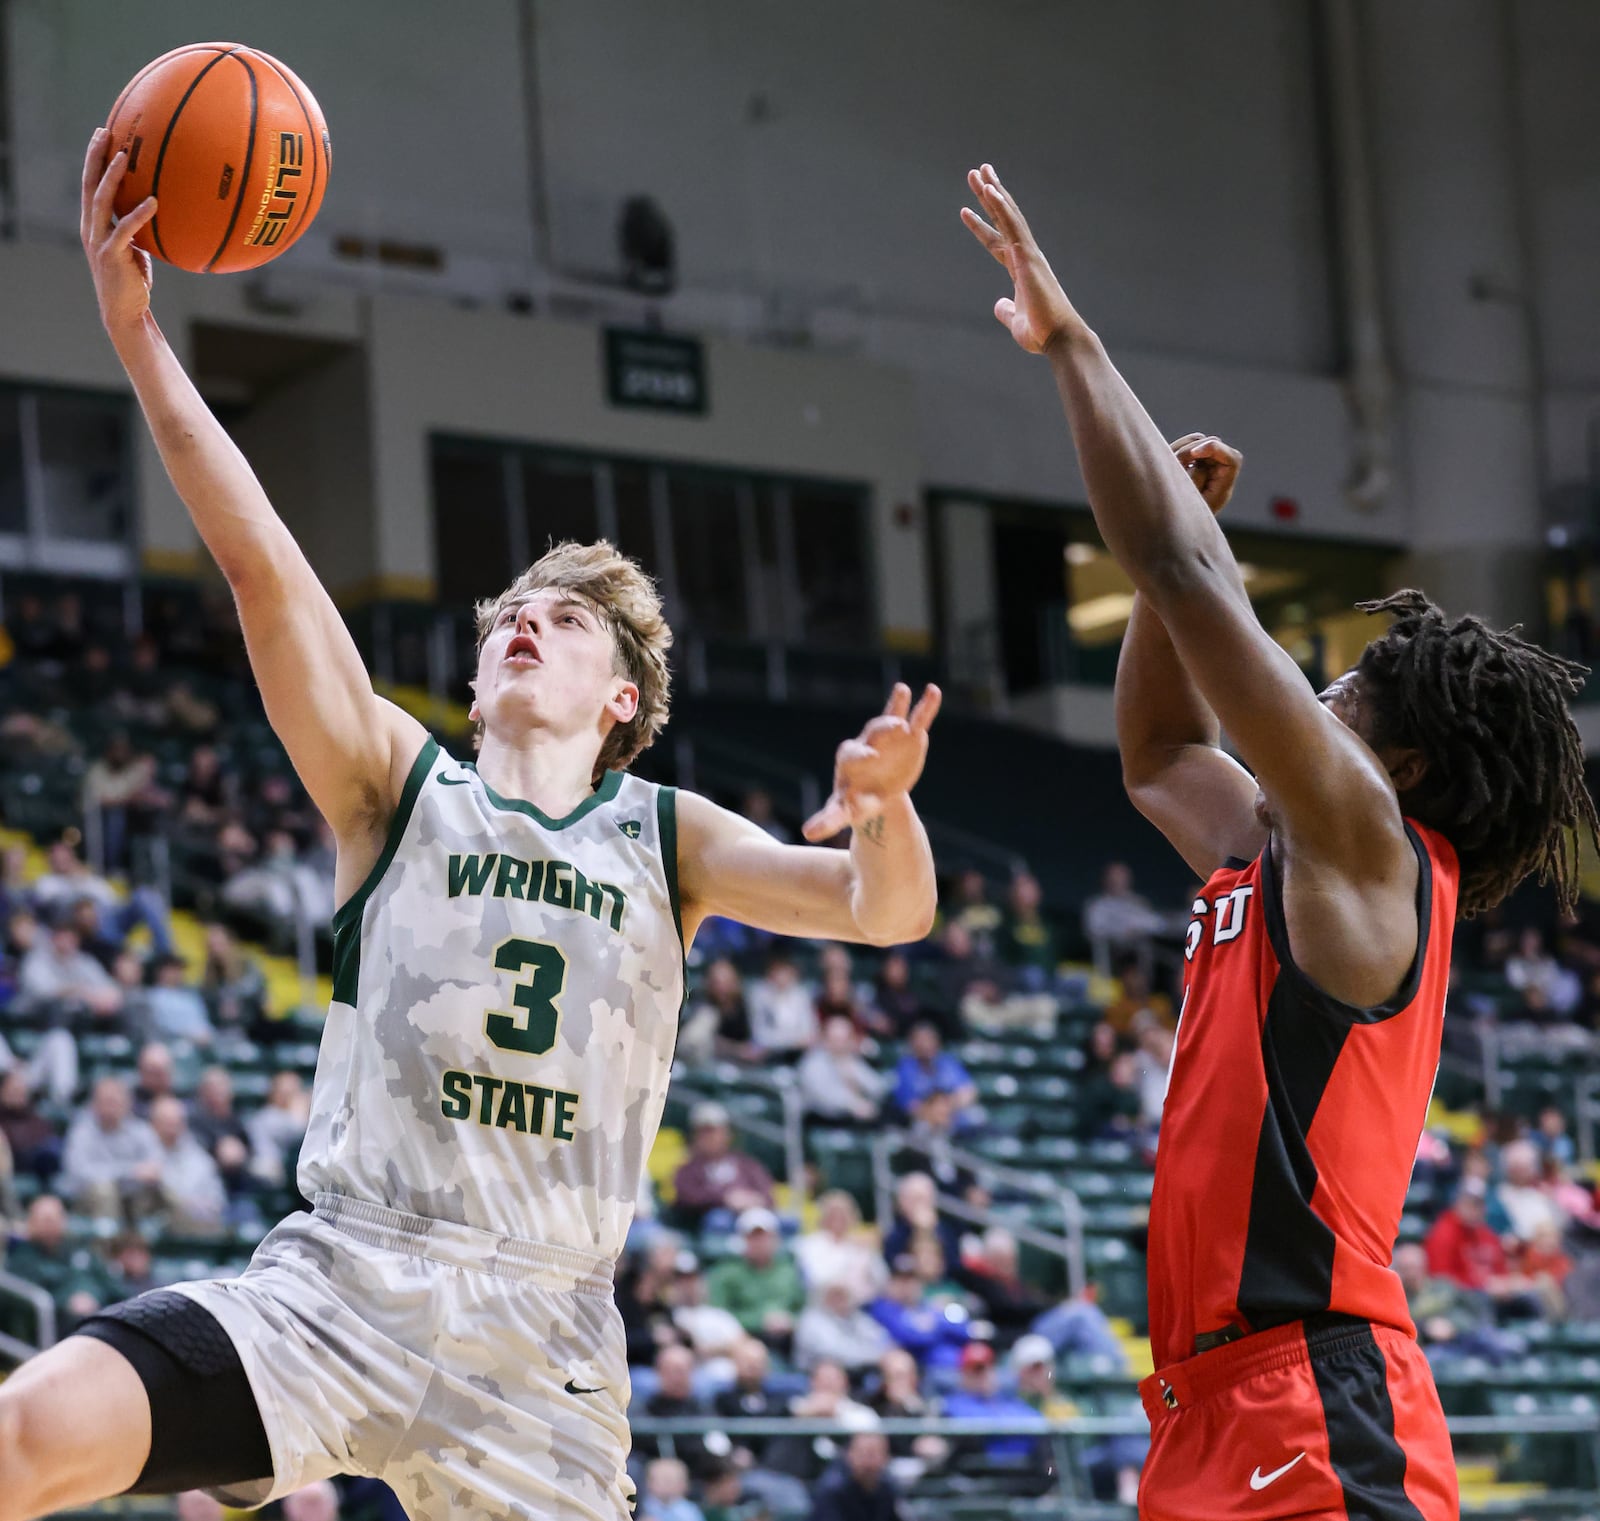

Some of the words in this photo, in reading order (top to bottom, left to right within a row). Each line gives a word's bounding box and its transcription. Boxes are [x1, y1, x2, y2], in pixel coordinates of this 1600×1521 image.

[251, 131, 304, 247] ELITE
[447, 853, 628, 935] WRIGHT
[483, 936, 568, 1057] 3
[440, 1068, 581, 1143] STATE
